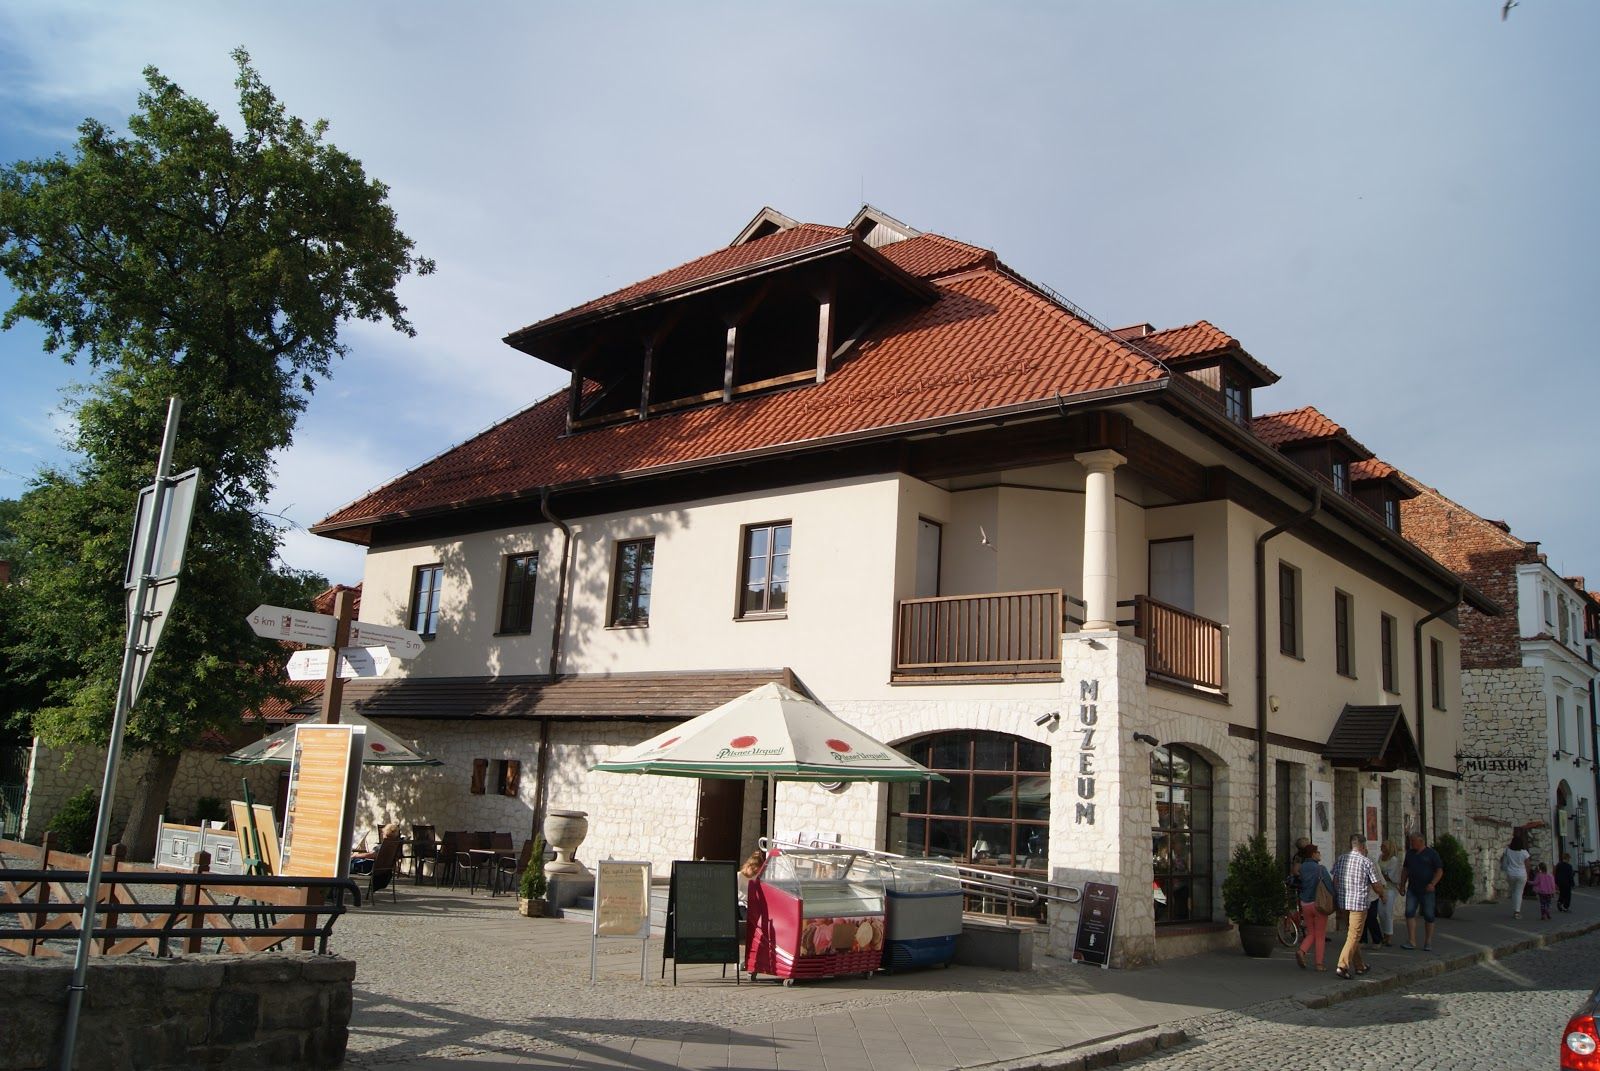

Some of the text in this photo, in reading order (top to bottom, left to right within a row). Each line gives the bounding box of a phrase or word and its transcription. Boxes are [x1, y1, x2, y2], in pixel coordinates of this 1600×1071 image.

[253, 615, 275, 627] 5 km
[406, 640, 411, 649] 5
[716, 747, 785, 759] Pilsner Urquell
[1075, 679, 1099, 825] MUZEUM
